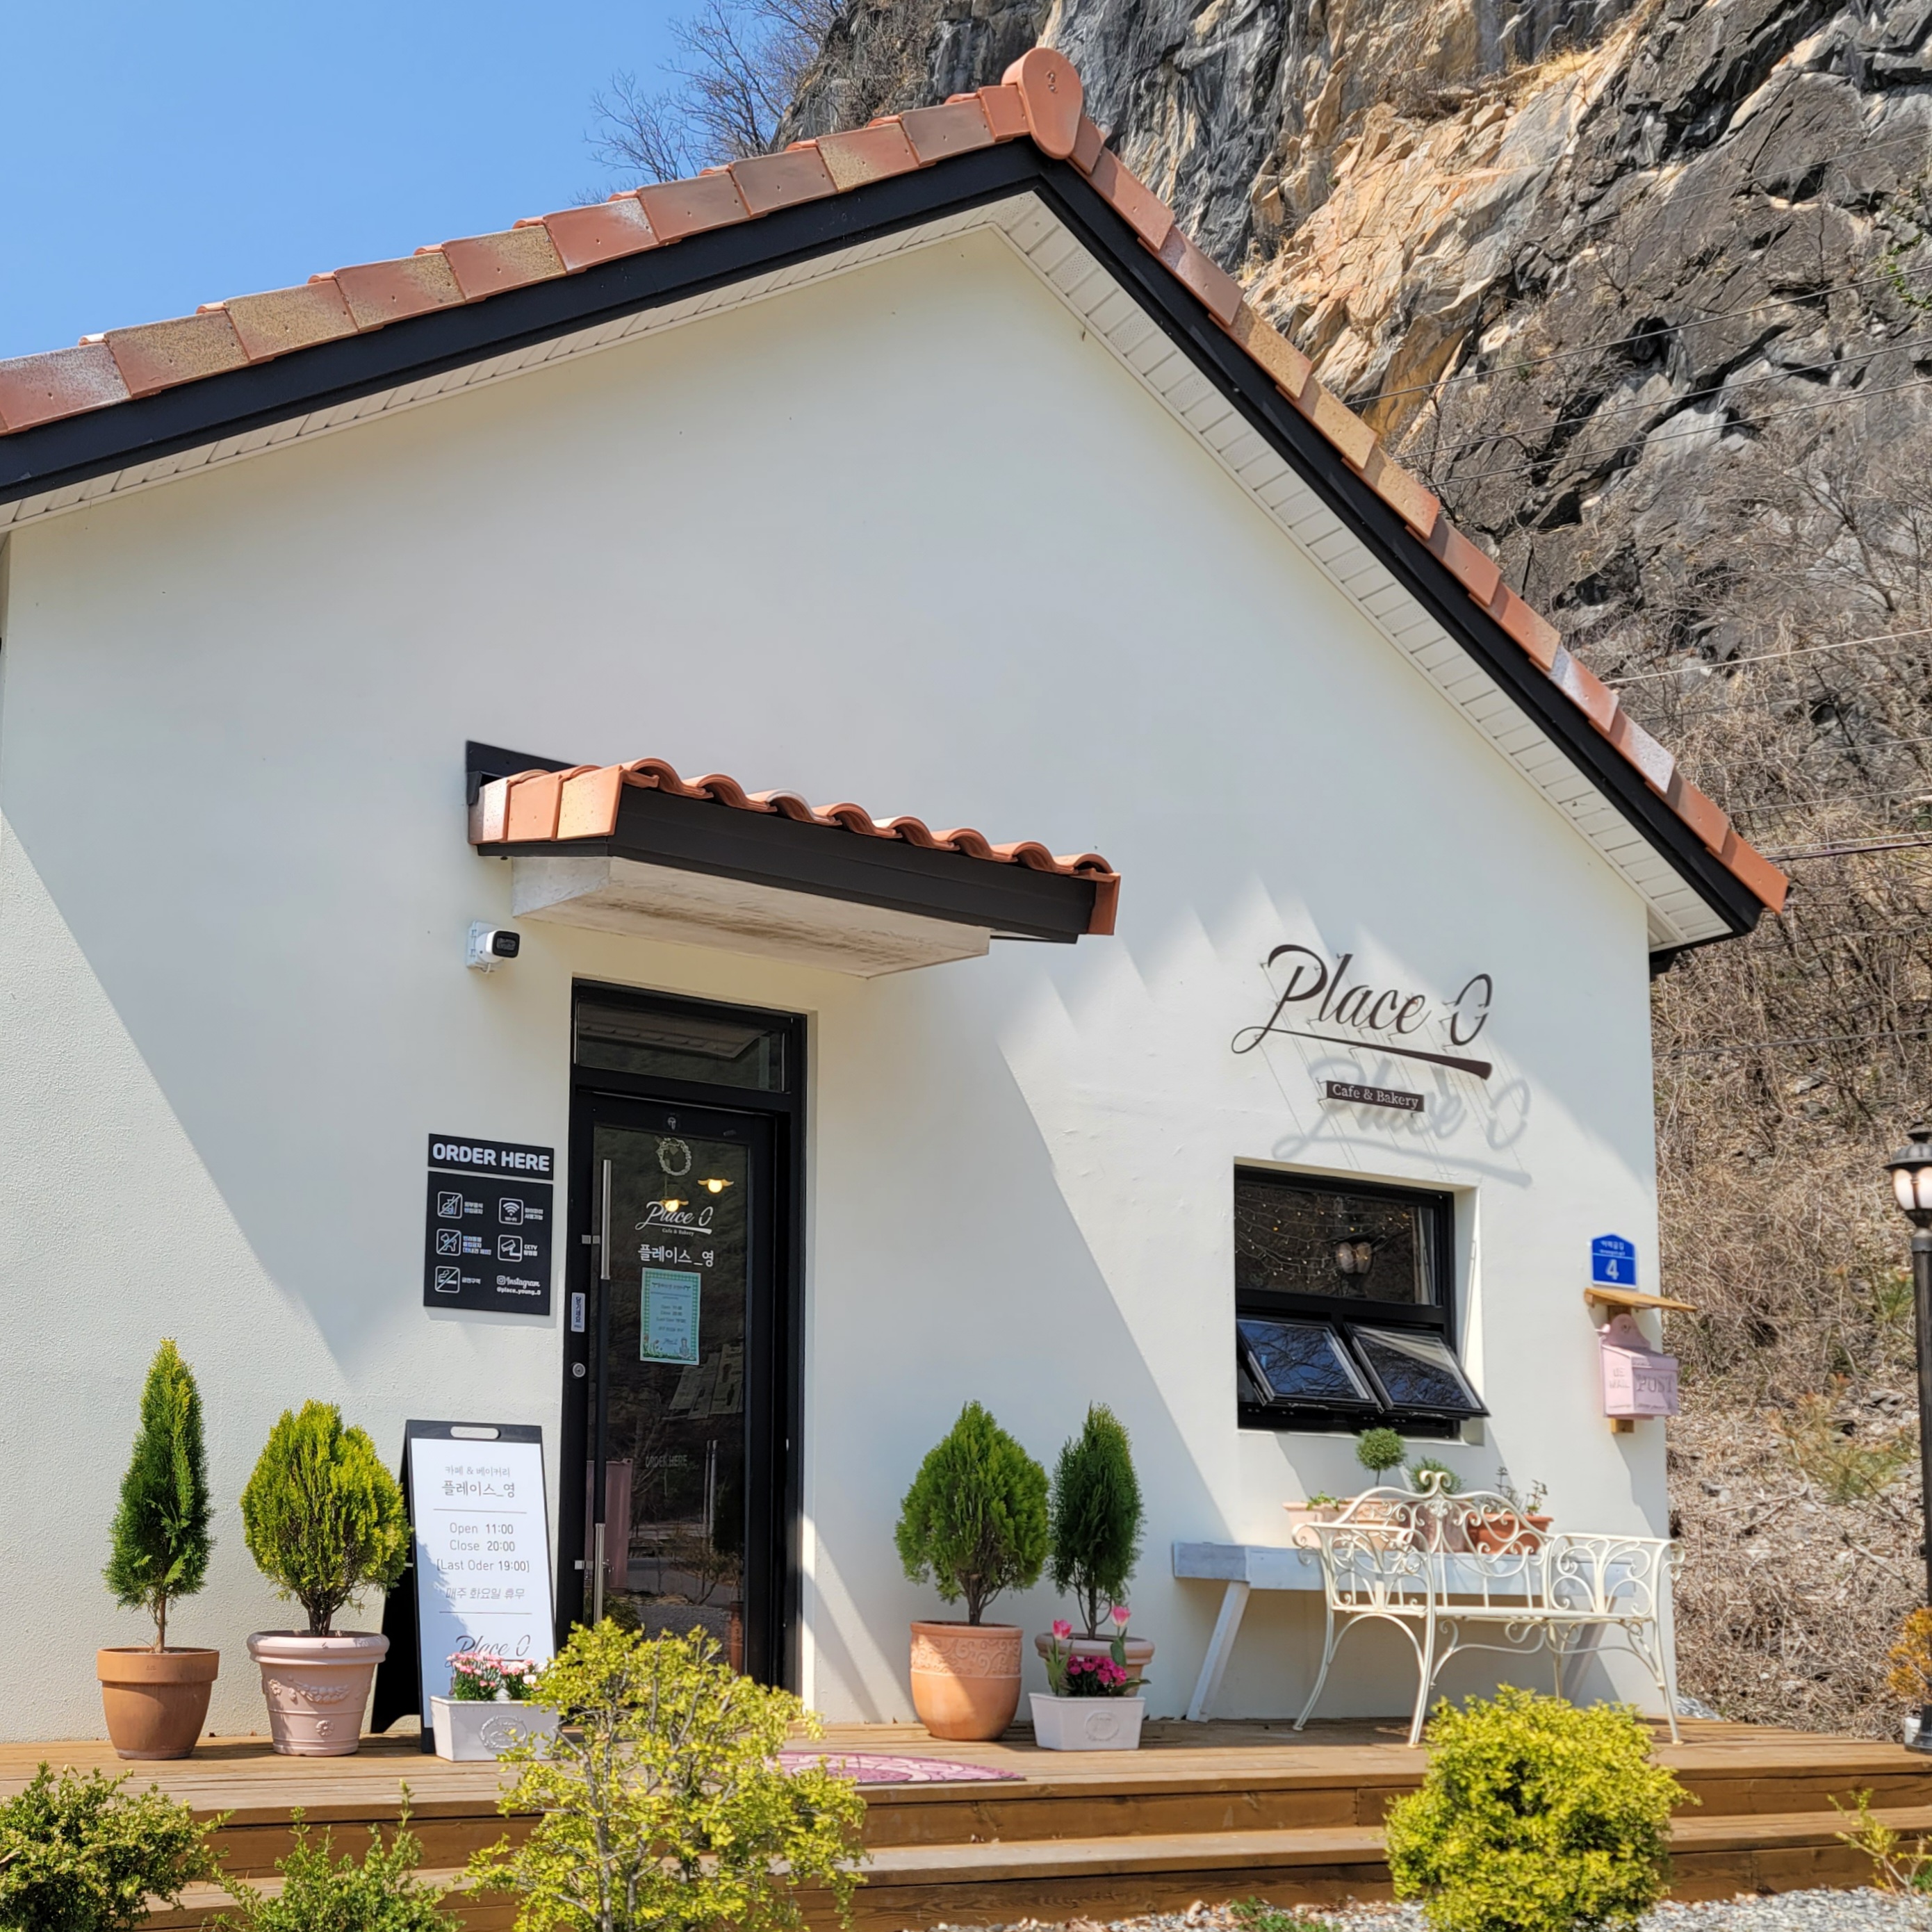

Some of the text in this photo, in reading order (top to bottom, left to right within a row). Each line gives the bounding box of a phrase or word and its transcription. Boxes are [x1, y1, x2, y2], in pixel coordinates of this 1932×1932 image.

[1231, 944, 1432, 1054] Place
[1332, 1084, 1418, 1110] Cafe & Bakery
[432, 1143, 550, 1172] ORDER HERE
[635, 1201, 695, 1230] Place
[638, 1244, 714, 1267] 플레이스_영
[1605, 1259, 1619, 1280] 4
[1637, 1375, 1673, 1393] POST
[669, 1455, 688, 1467] HERE
[445, 1465, 511, 1477] 카페 & 베이커리
[441, 1480, 515, 1498] 플레이스_영
[450, 1522, 514, 1535] Open 11:00
[450, 1539, 515, 1552] Close 20:00
[468, 1559, 494, 1571] Oder
[445, 1587, 525, 1599] 매주 화요일 휴무
[450, 1635, 509, 1660] Place
